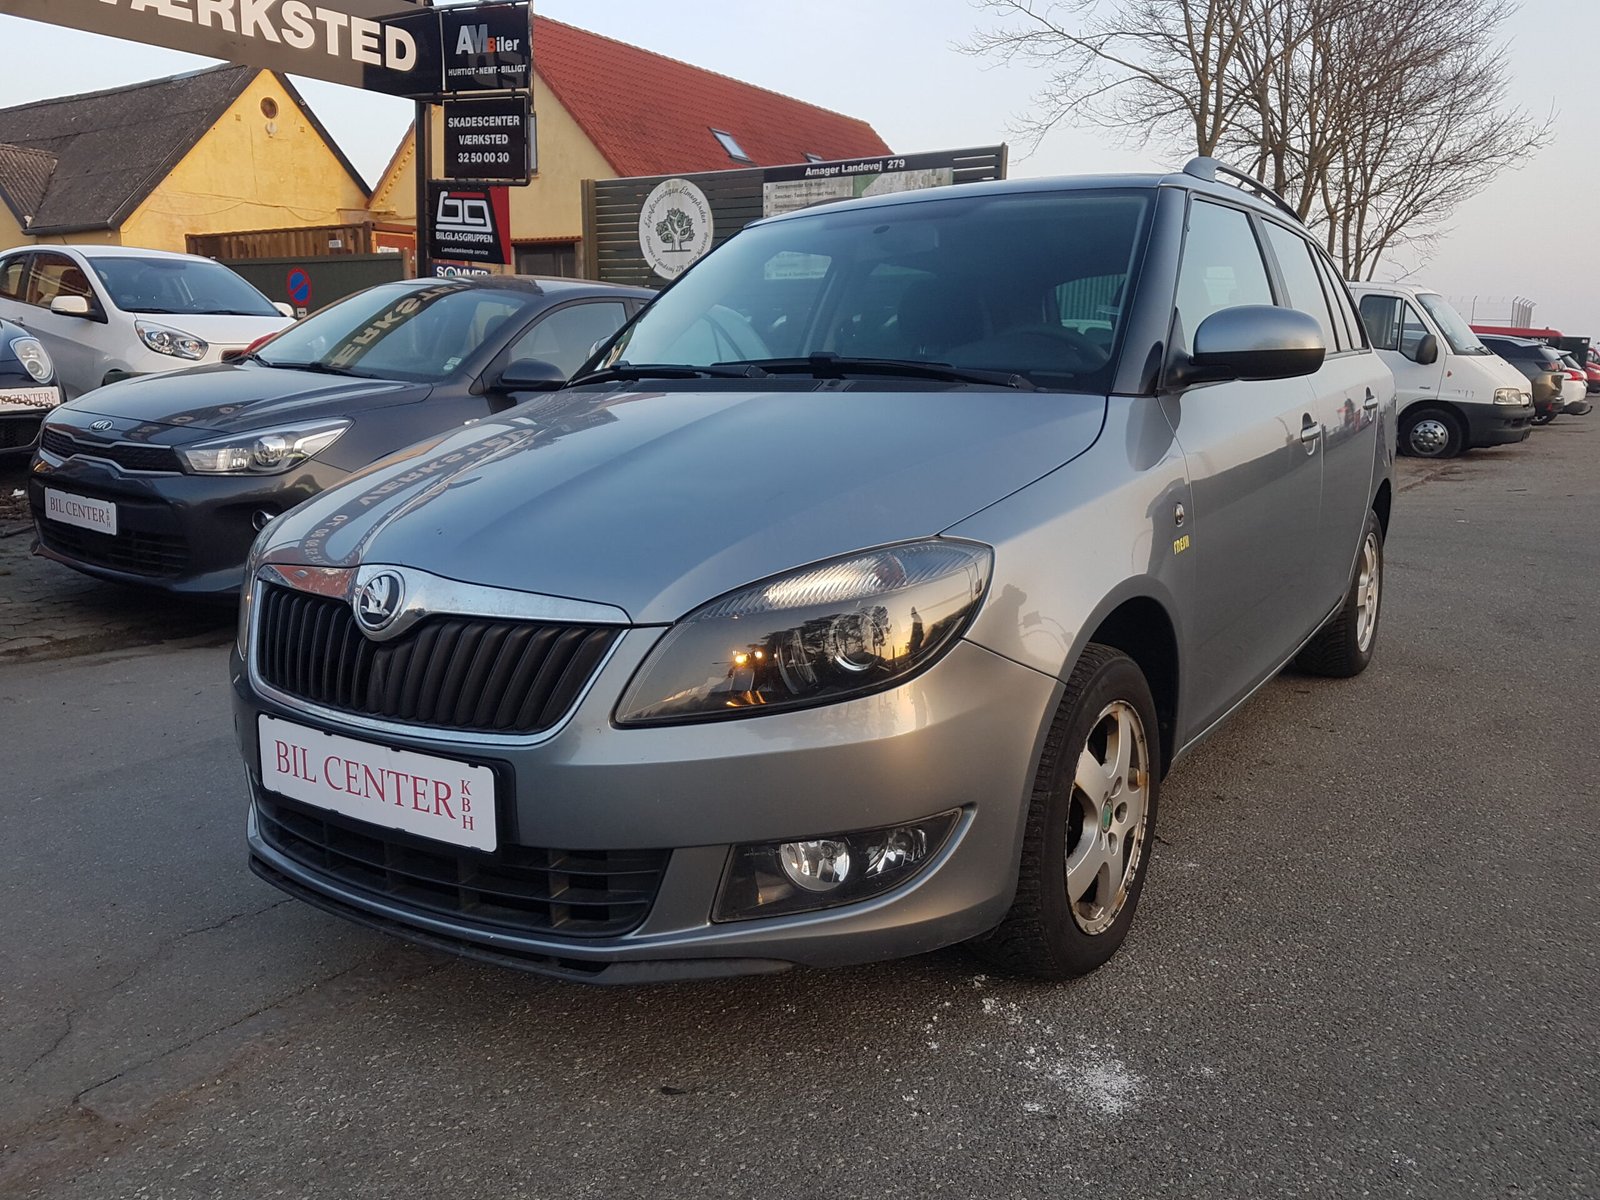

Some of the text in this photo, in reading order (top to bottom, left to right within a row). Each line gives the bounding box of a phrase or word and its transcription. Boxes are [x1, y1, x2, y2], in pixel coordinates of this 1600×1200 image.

[448, 115, 520, 128] SKADESCENTER
[458, 134, 509, 145] VÆRKSTED
[804, 158, 905, 176] Amager Landevej 279
[435, 231, 493, 244] BILGLASGRUPPEN
[50, 497, 106, 524] BIL CENTER
[274, 739, 457, 820] BIL CENTER
